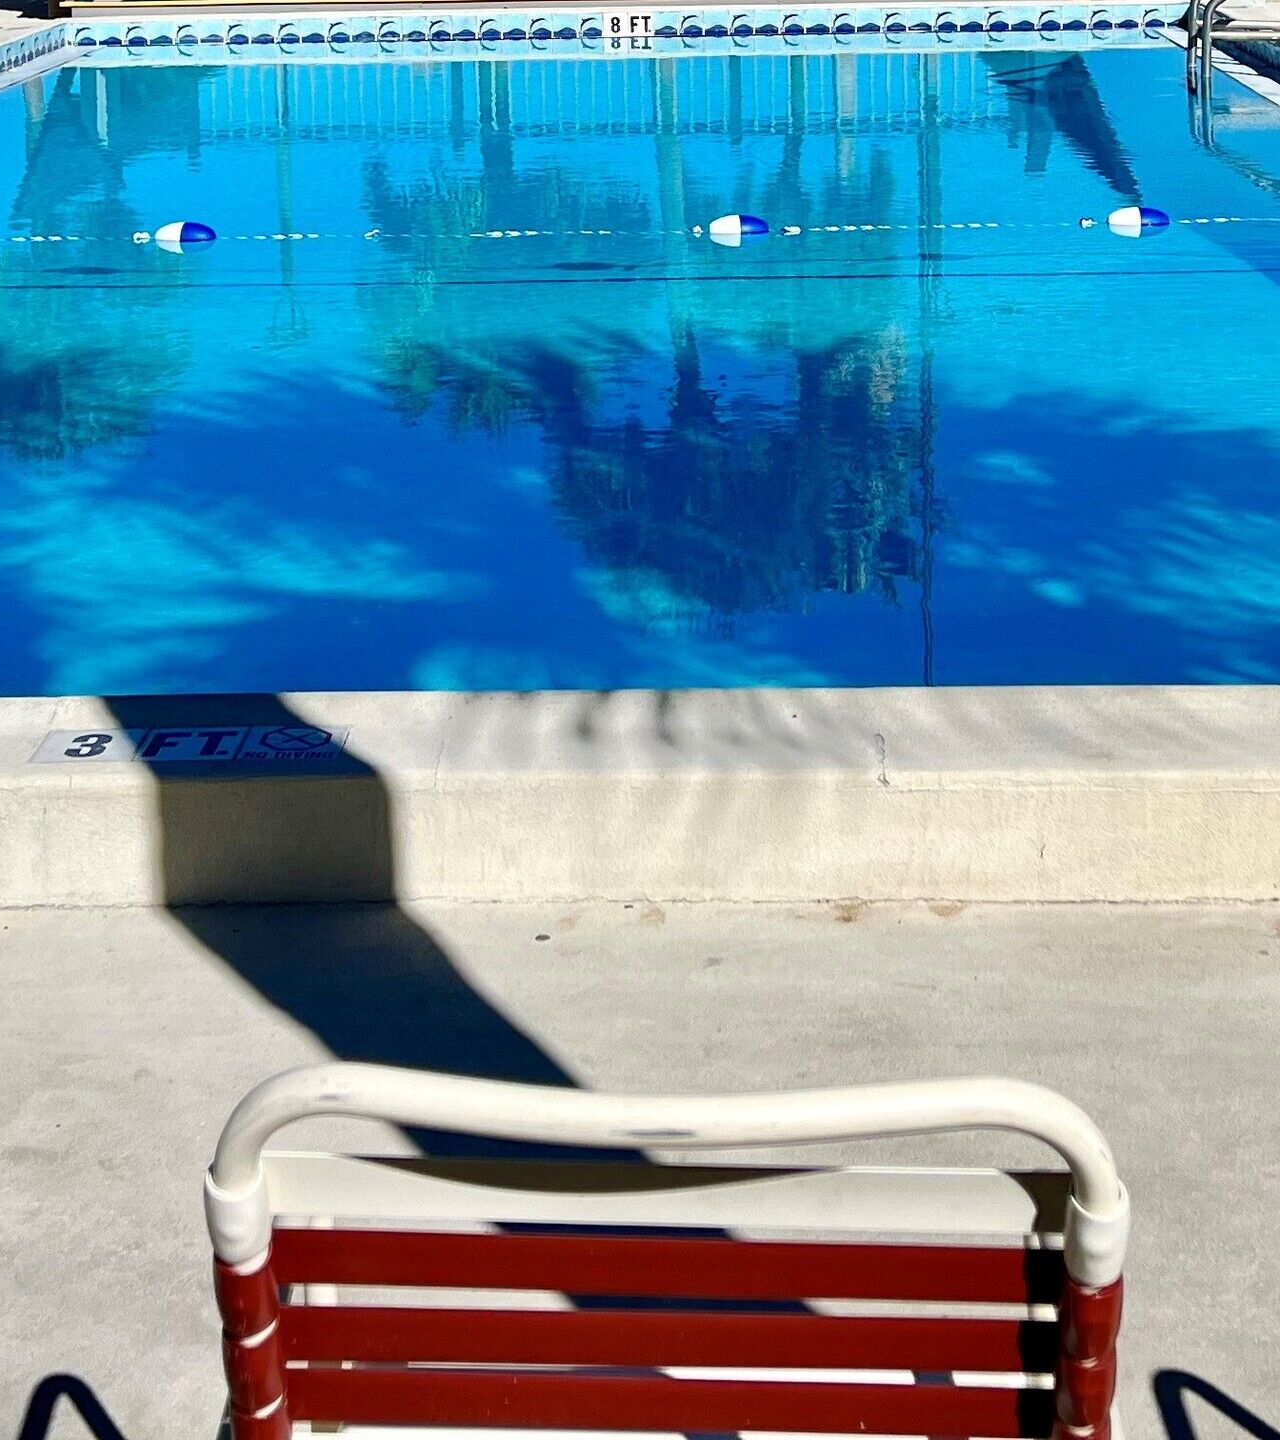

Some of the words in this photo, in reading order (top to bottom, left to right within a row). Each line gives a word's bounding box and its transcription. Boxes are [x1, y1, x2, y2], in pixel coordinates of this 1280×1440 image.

[611, 16, 621, 33] 8
[630, 15, 652, 33] FT.
[64, 733, 114, 758] 3
[140, 730, 239, 758] FT.
[243, 751, 268, 760] NO
